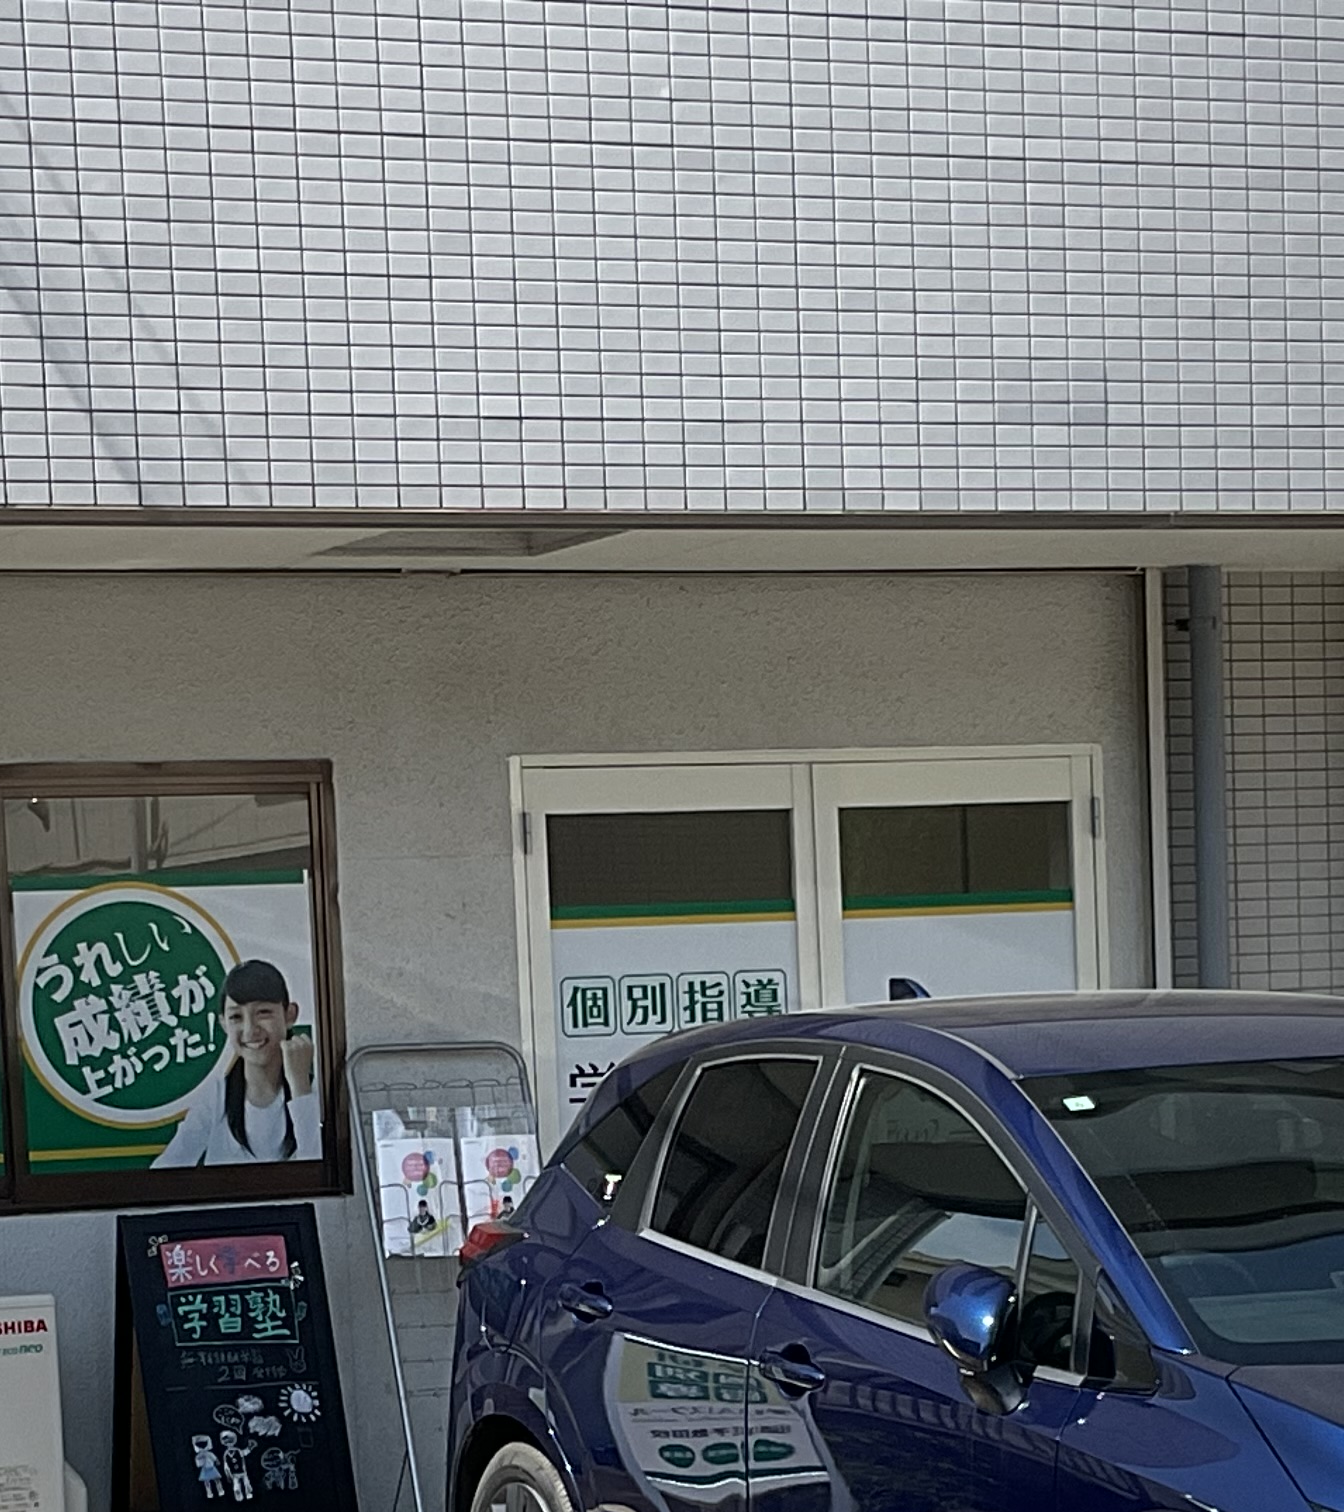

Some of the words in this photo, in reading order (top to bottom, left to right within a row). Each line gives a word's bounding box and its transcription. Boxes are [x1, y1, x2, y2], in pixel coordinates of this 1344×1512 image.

[36, 916, 194, 1003] うれしい
[565, 977, 783, 1028] 個別指導
[57, 963, 217, 1066] 成績が
[81, 1013, 219, 1101] 上がった!
[177, 1288, 291, 1339] 学習塾
